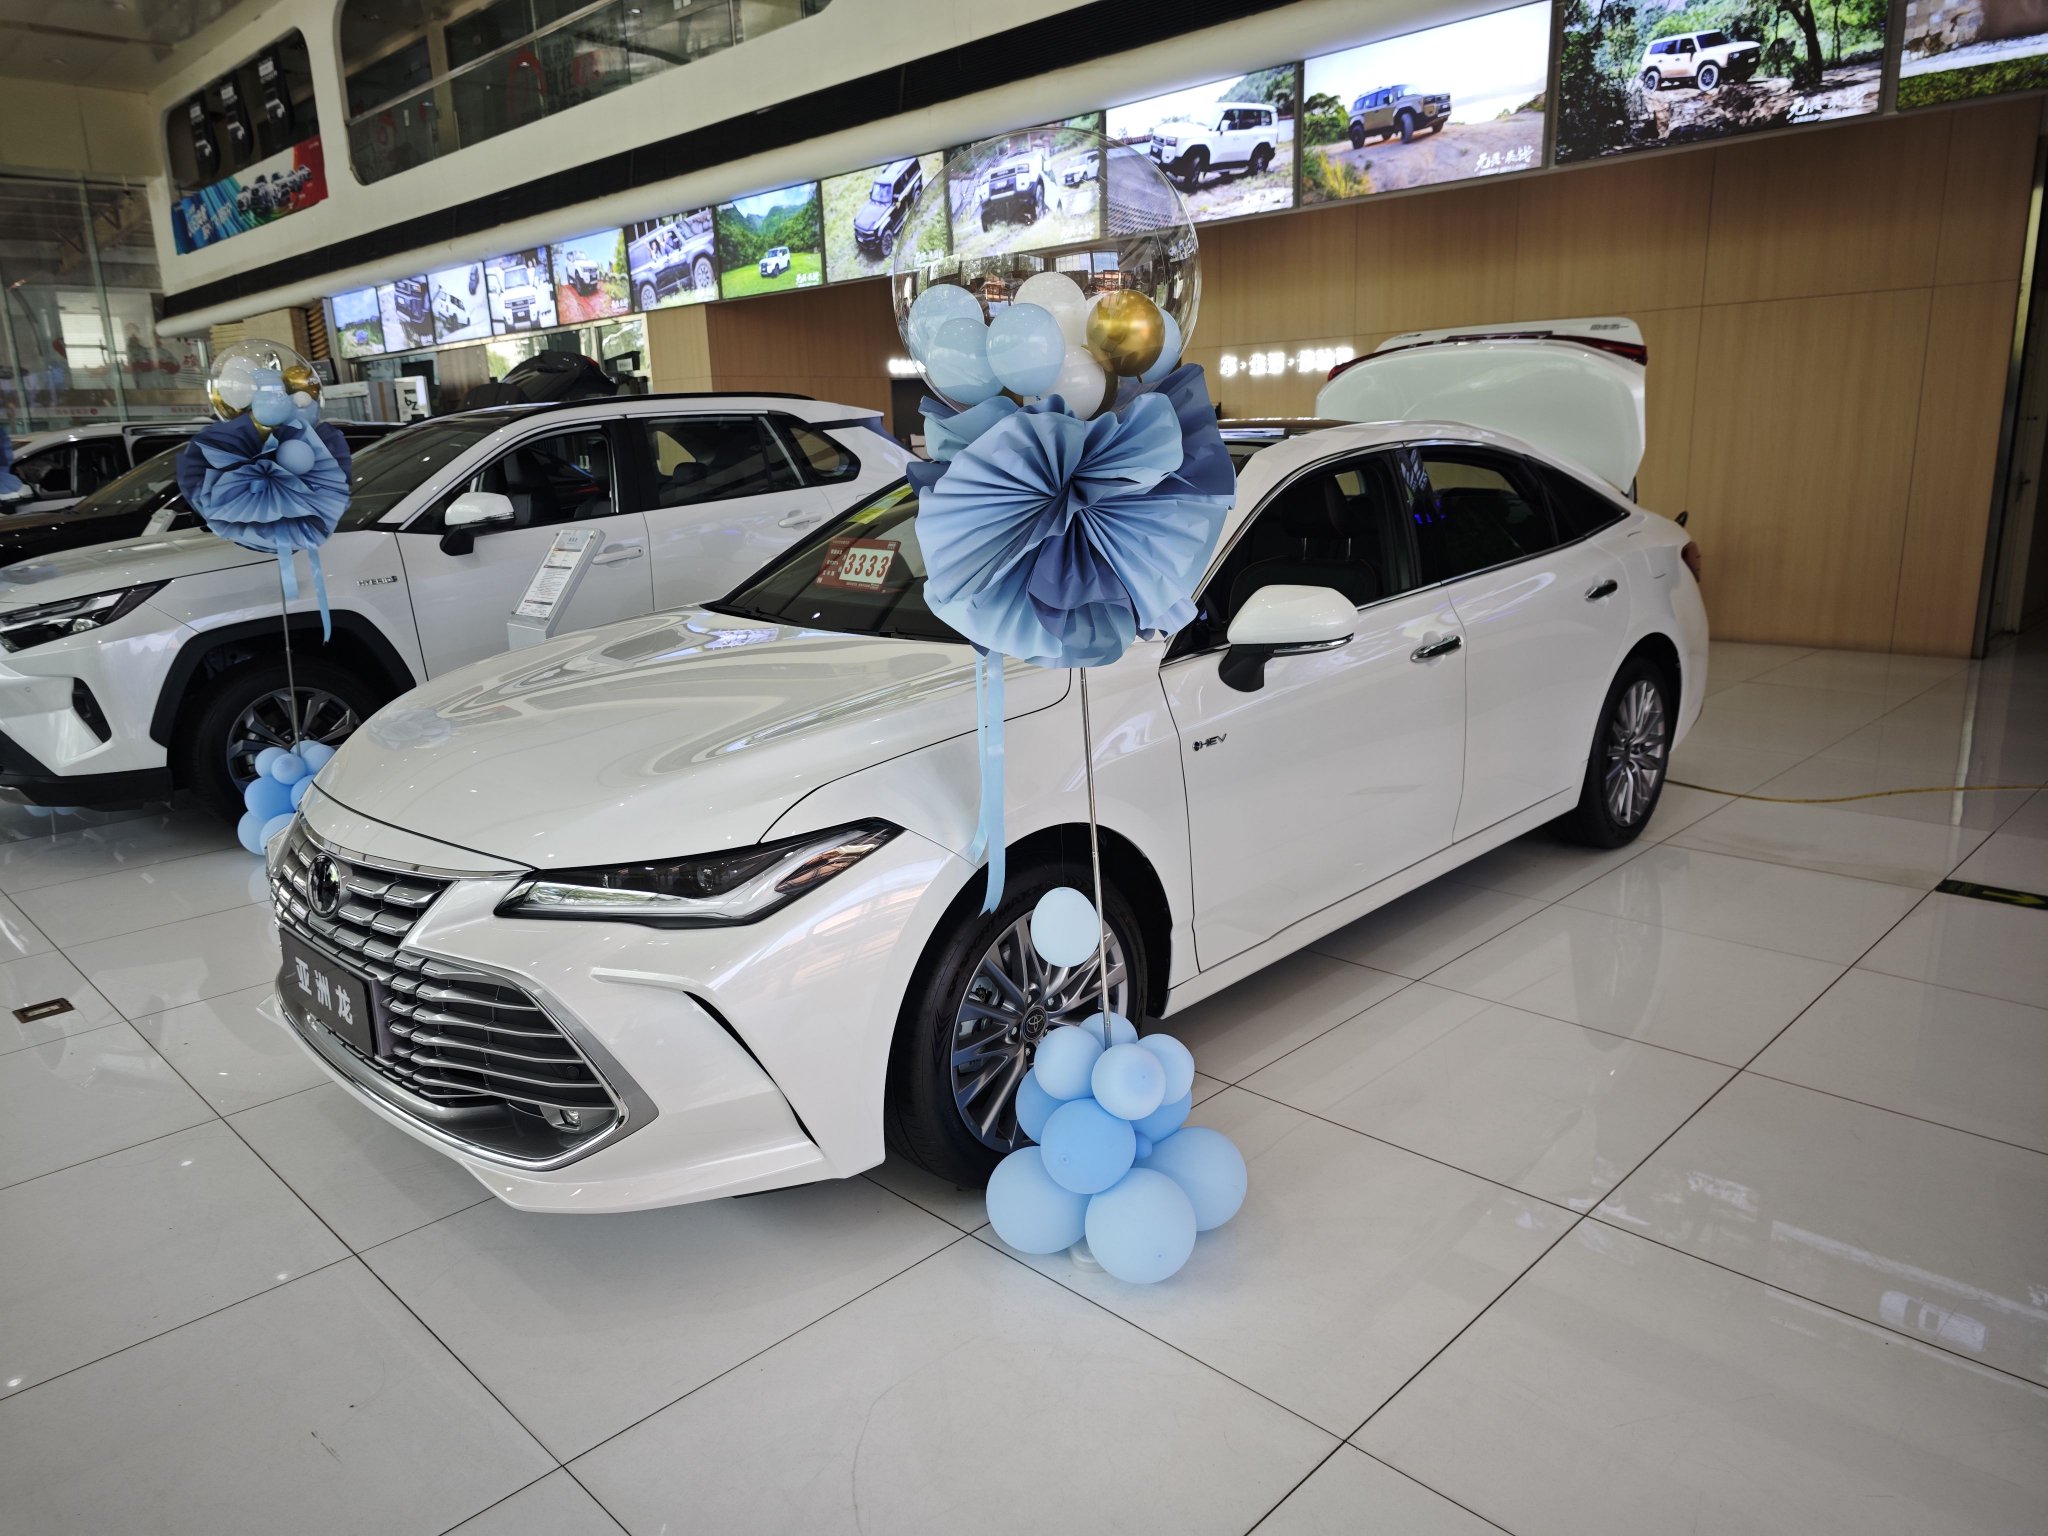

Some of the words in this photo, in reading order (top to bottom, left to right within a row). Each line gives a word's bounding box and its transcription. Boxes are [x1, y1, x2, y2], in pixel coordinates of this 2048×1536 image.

[844, 553, 890, 578] 3333
[356, 577, 393, 587] HYBRID
[295, 956, 353, 1025] 亚洲龙
